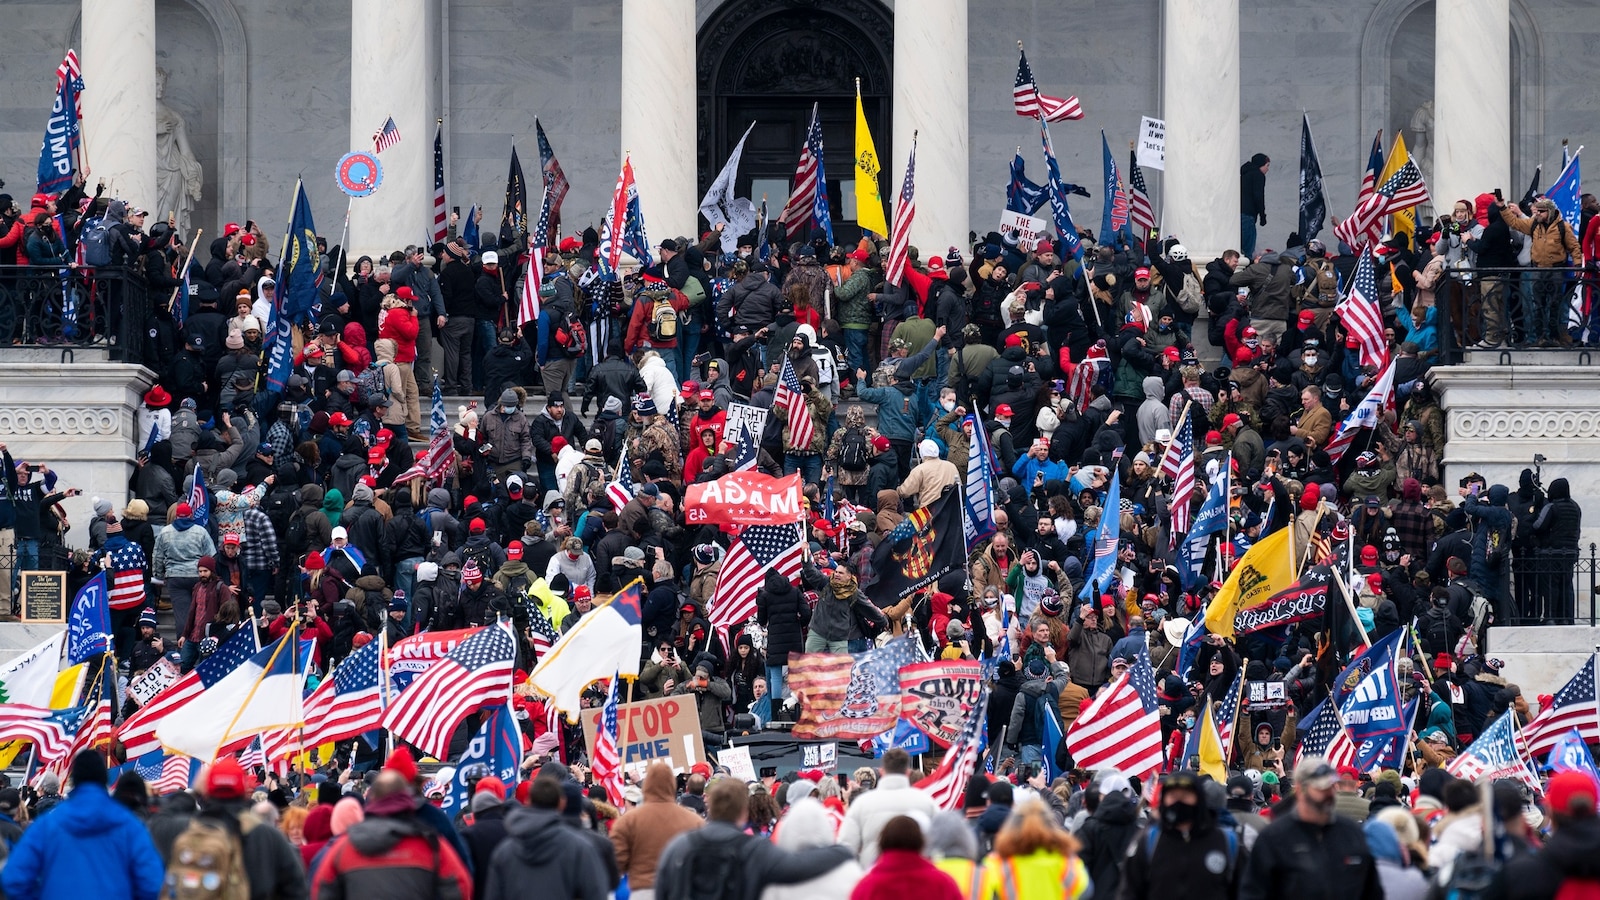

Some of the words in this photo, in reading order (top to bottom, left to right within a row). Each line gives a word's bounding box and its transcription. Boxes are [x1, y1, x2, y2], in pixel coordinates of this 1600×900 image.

[47, 94, 70, 174] RUMP
[1016, 216, 1031, 229] THE
[1001, 223, 1038, 241] CHIDRE
[736, 418, 759, 433] LKE
[133, 666, 161, 695] STOP
[1250, 682, 1265, 690] WE
[1250, 694, 1265, 702] ONE
[1251, 688, 1265, 696] ARE
[617, 738, 670, 764] THE
[803, 745, 819, 754] WE
[804, 753, 819, 761] ARE
